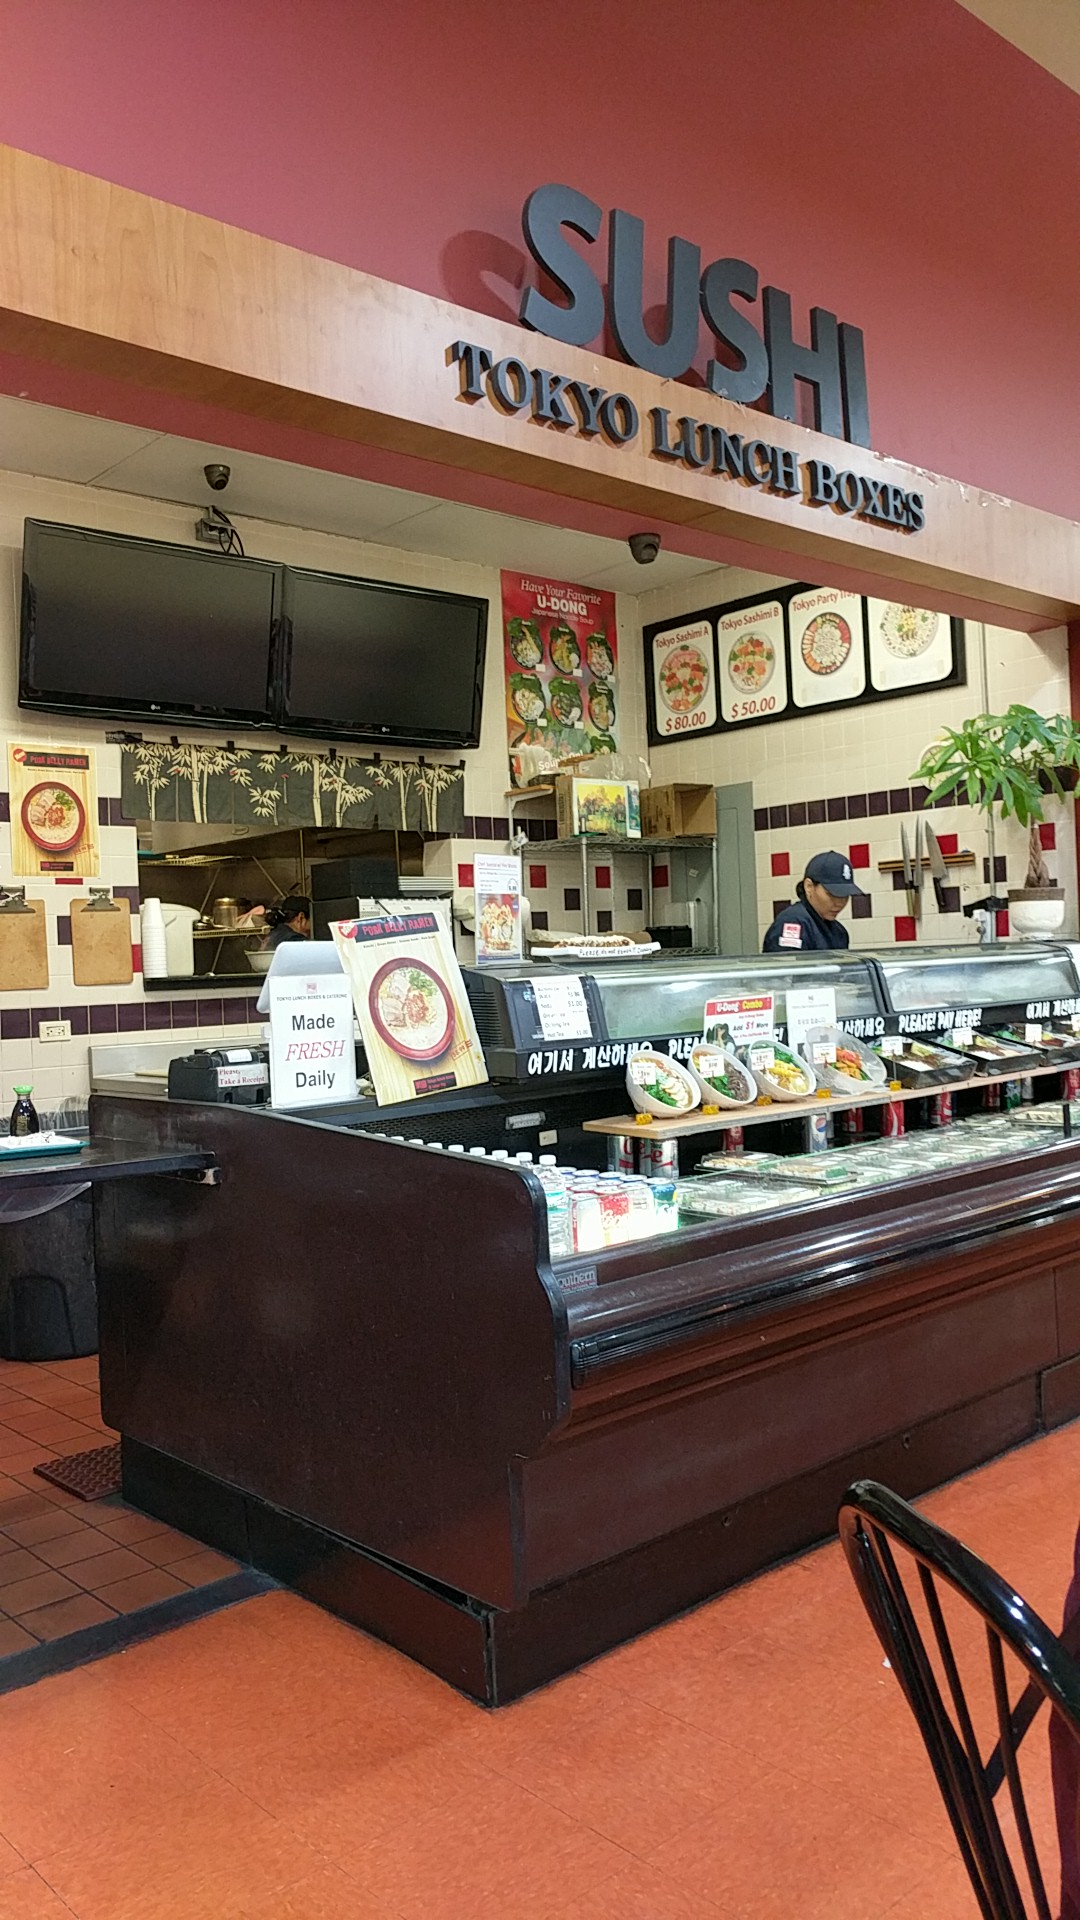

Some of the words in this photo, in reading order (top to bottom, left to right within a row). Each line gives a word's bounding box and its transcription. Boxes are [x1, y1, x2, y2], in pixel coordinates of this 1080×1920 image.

[519, 183, 871, 448] SUSHI
[449, 340, 640, 443] TOKYO
[650, 407, 802, 495] LUNCH
[808, 458, 926, 533] BOXES
[521, 580, 544, 594] Have
[545, 584, 565, 597] Your
[567, 588, 601, 605] Favorite
[792, 599, 816, 611] Tokyo
[817, 593, 839, 605] Party
[536, 594, 588, 616] U-DONG
[721, 619, 743, 631] Tokyo
[743, 610, 773, 626] Sashimi
[773, 607, 780, 617] B
[655, 636, 675, 648] Tokyo
[675, 630, 704, 643] Sashimi
[703, 626, 709, 636] A
[362, 924, 382, 936] PORK
[385, 921, 407, 933] BELLY
[408, 917, 433, 929] RAMEN
[716, 1002, 740, 1013] U-Dong
[742, 1000, 763, 1009] Combo
[292, 1013, 335, 1031] Made
[745, 1021, 755, 1030] $1
[898, 1012, 936, 1033] PLEASE!
[937, 1011, 955, 1030] PAY
[955, 1008, 982, 1028] HERE!
[285, 1040, 346, 1061] FRESH
[527, 1048, 573, 1076] 여기서
[241, 1076, 265, 1084] Receipt
[296, 1070, 335, 1089] Daily
[557, 1271, 595, 1287] outhern
